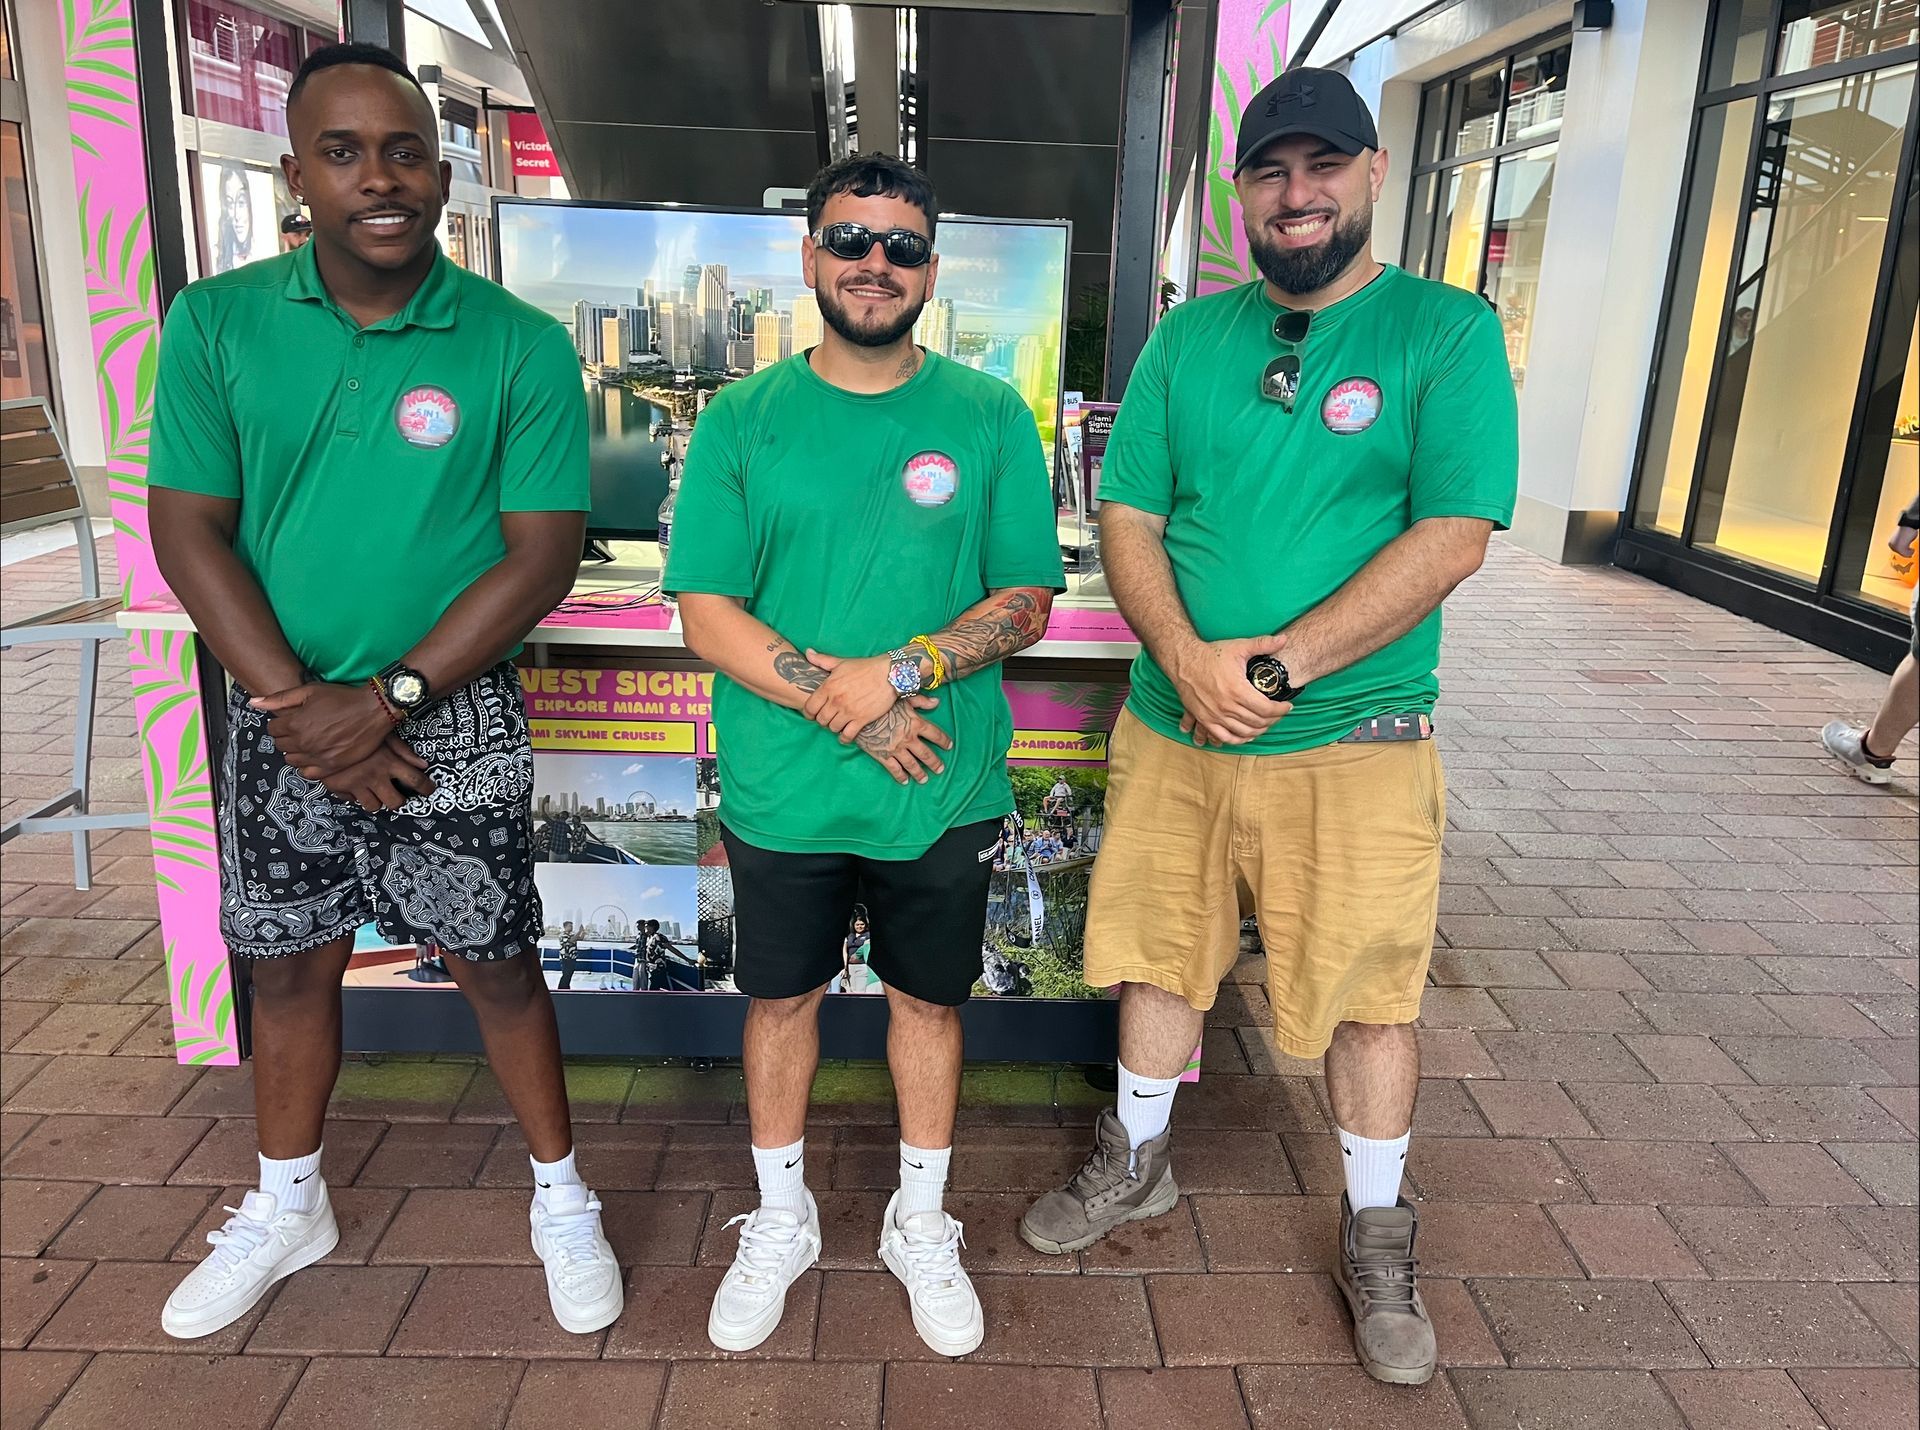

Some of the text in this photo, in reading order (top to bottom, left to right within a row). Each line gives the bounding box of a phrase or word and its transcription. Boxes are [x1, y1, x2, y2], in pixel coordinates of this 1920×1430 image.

[516, 157, 550, 168] Secret
[1330, 380, 1379, 399] MIAMI
[403, 388, 456, 413] MIAMI
[423, 409, 434, 419] IN
[1088, 414, 1112, 422] Miami
[1088, 420, 1112, 429] Sights
[908, 454, 956, 472] MIAMI
[615, 671, 716, 697] SIGHT
[534, 698, 608, 713] EXPLORE
[613, 701, 664, 714] MIAMI
[670, 702, 681, 715] &
[555, 729, 608, 740] SKYLINE
[612, 730, 666, 742] CRUISES
